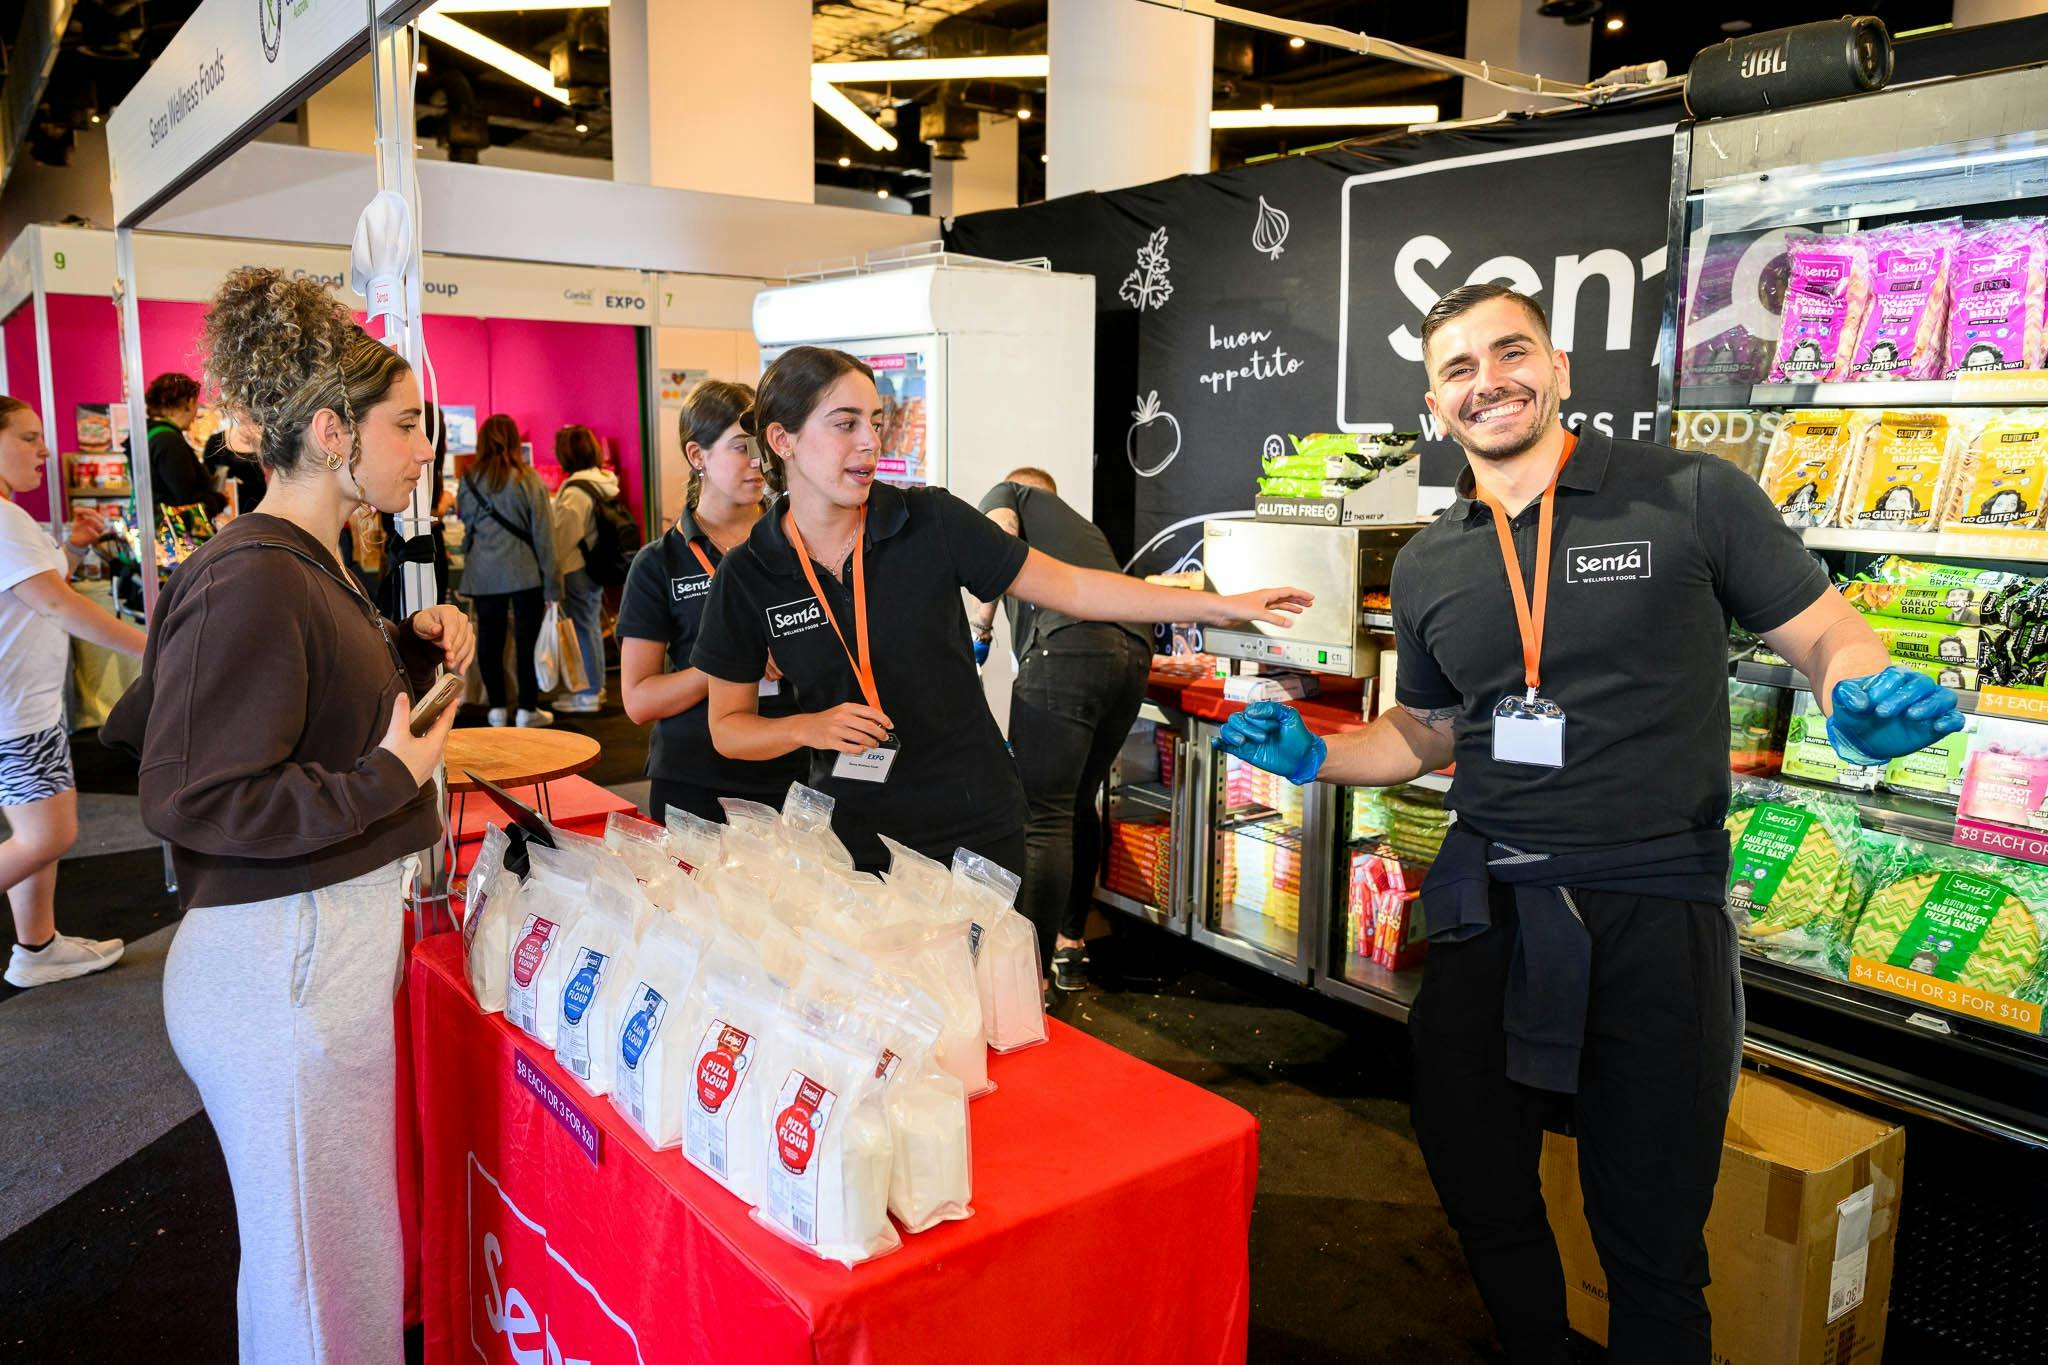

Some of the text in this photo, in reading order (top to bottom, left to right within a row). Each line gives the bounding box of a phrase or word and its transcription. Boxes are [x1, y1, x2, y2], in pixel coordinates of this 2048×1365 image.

[1740, 46, 1787, 79] JBL
[149, 48, 225, 148] Senza Wellness Foods
[53, 251, 66, 270] 9
[424, 281, 458, 295] oup
[605, 296, 645, 310] EXPO
[666, 293, 673, 307] 7
[1969, 307, 2009, 319] BREAD
[1209, 324, 1272, 350] buon
[1200, 346, 1304, 394] appetito
[1785, 361, 1819, 371] GLUTEN
[1862, 361, 1898, 371] GLUTEN
[2003, 361, 2023, 369] WAY!
[1899, 430, 1918, 438] GLUTEN
[2002, 434, 2022, 442] GLUTEN
[1257, 503, 1325, 517] GLUTEN FREE
[1872, 511, 1912, 520] GLUTEN
[1976, 512, 2018, 524] GLUTEN
[1901, 598, 1938, 608] GARLIC
[1901, 606, 1935, 615] BREAD
[783, 627, 804, 636] WELLNESS
[1985, 693, 2003, 706] $4
[1806, 737, 1826, 745] GLUTEN
[1758, 830, 1788, 842] GLUTEN FREE
[1960, 827, 1978, 840] $8
[1982, 832, 2026, 851] EACH
[1743, 834, 1795, 853] CAULIFLOWER
[1742, 842, 1788, 860] PIZZA BASE
[1943, 898, 1980, 914] GLUTEN FREE
[1925, 901, 1988, 926] CAULIFLOWER
[1925, 910, 1951, 925] PIZZA
[1952, 919, 1978, 933] BASE
[525, 943, 538, 953] SELF
[518, 957, 534, 969] FLOUR
[519, 949, 539, 963] RAISING
[573, 981, 591, 993] PLAIN
[1855, 964, 2031, 1022] $4 EACH OR 3 FOR $10
[568, 990, 588, 1004] FLOUR
[631, 1021, 645, 1036] PLAIN
[625, 1030, 643, 1048] FLOUR
[707, 1060, 730, 1080] PIZZA
[701, 1071, 728, 1092] FLOUR
[516, 1059, 594, 1151] $8 EACH OR 3 FOR $20
[785, 1117, 808, 1138] PIZZA
[779, 1128, 809, 1152] FLOUR
